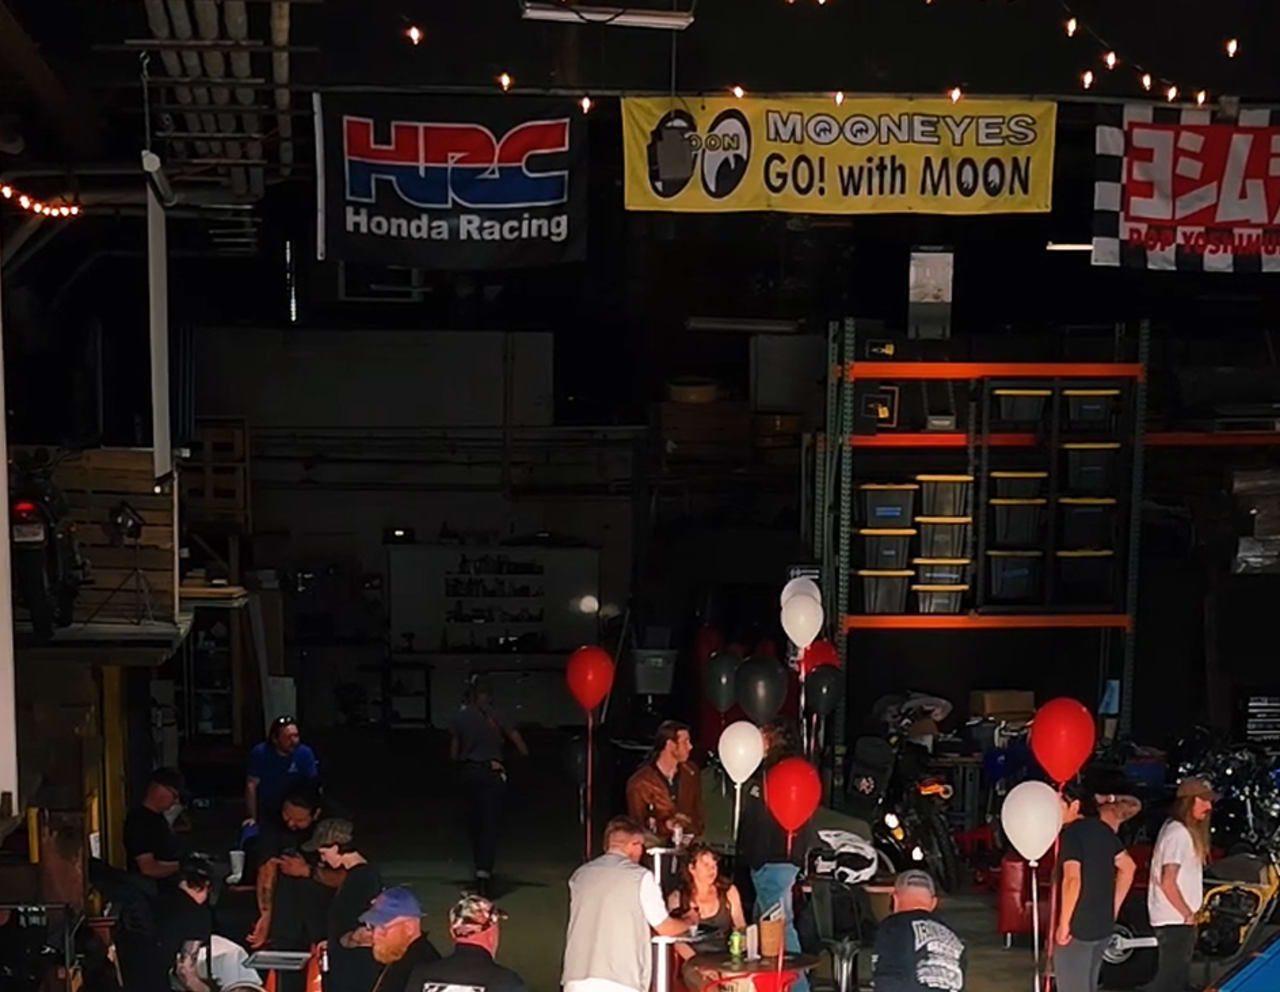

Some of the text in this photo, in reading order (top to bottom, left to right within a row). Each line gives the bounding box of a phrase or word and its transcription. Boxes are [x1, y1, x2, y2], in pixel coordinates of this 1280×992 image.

[766, 110, 1037, 147] MOONEYES
[343, 115, 571, 208] HRC
[763, 153, 1032, 198] GO! with MOON
[345, 206, 569, 242] Honda Racing
